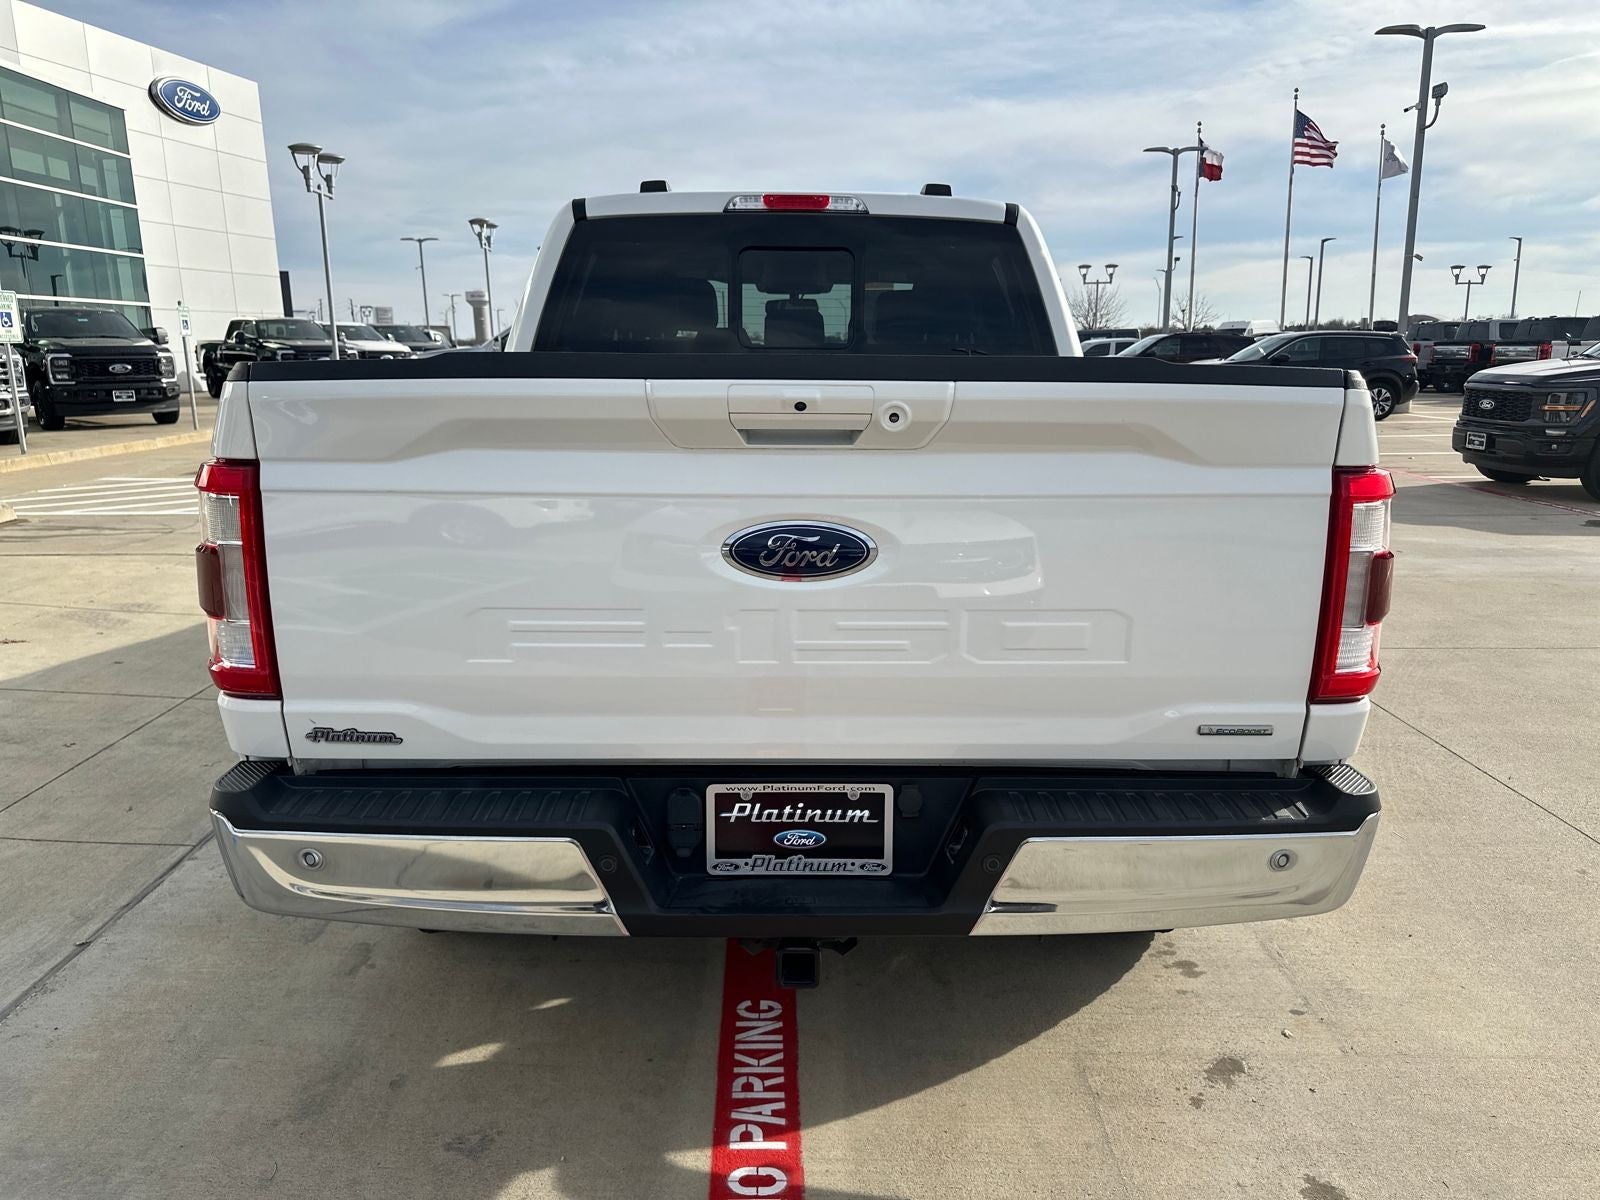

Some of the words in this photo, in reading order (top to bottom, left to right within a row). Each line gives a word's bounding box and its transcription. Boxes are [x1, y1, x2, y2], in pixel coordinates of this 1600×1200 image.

[174, 86, 211, 117] Ford
[759, 533, 841, 567] Ford
[305, 727, 403, 744] Platinum
[719, 803, 879, 823] Platinum
[783, 832, 816, 846] Ford
[750, 855, 853, 872] Platinum
[729, 999, 787, 1150] PARKING
[727, 1166, 788, 1200] O
